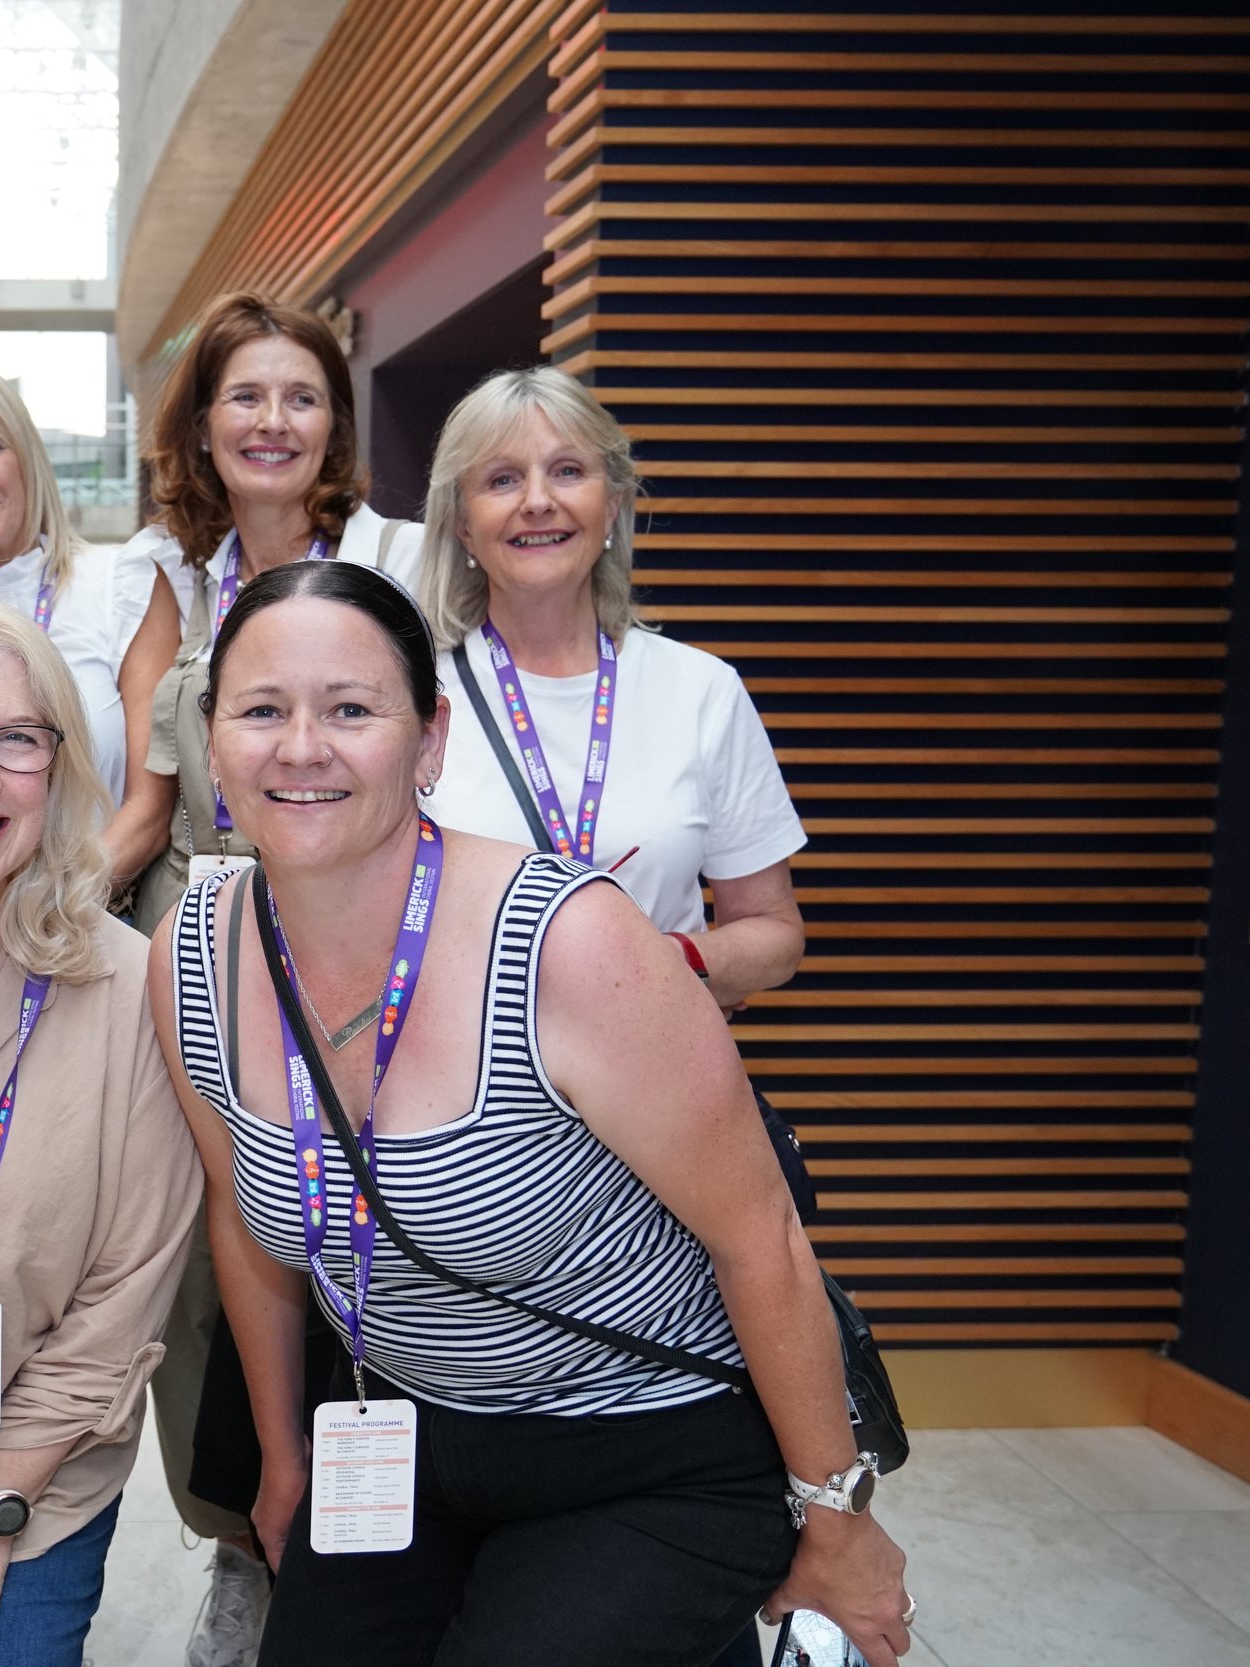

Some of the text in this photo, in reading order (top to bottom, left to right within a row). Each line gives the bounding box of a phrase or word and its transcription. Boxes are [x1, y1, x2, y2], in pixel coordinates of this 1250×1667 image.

[403, 877, 425, 931] LIMERICK
[413, 898, 430, 933] SINGS
[288, 1055, 302, 1089] SINGS
[329, 1419, 404, 1429] FESTIVAL PROGRAMME
